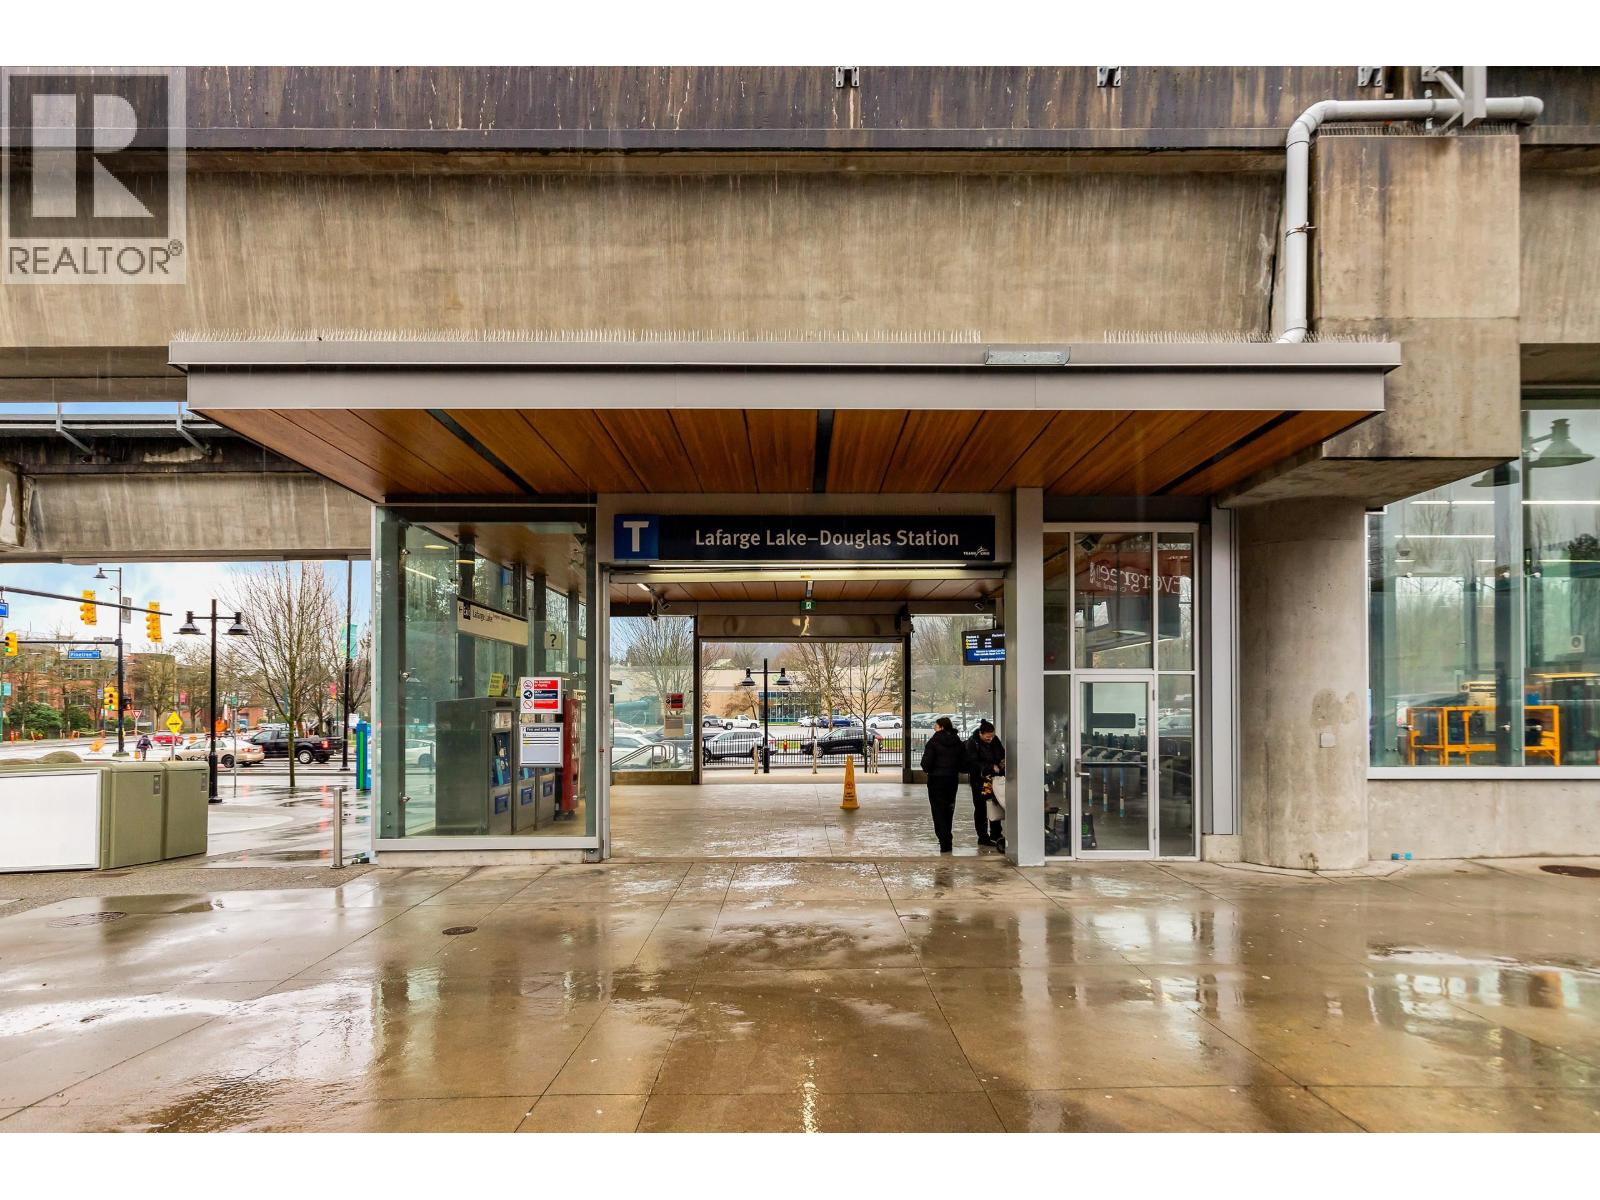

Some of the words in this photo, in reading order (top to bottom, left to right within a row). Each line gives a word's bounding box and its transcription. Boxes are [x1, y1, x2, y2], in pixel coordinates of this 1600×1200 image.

[623, 521, 650, 552] T
[695, 529, 761, 549] Lafarge
[896, 529, 959, 546] Station
